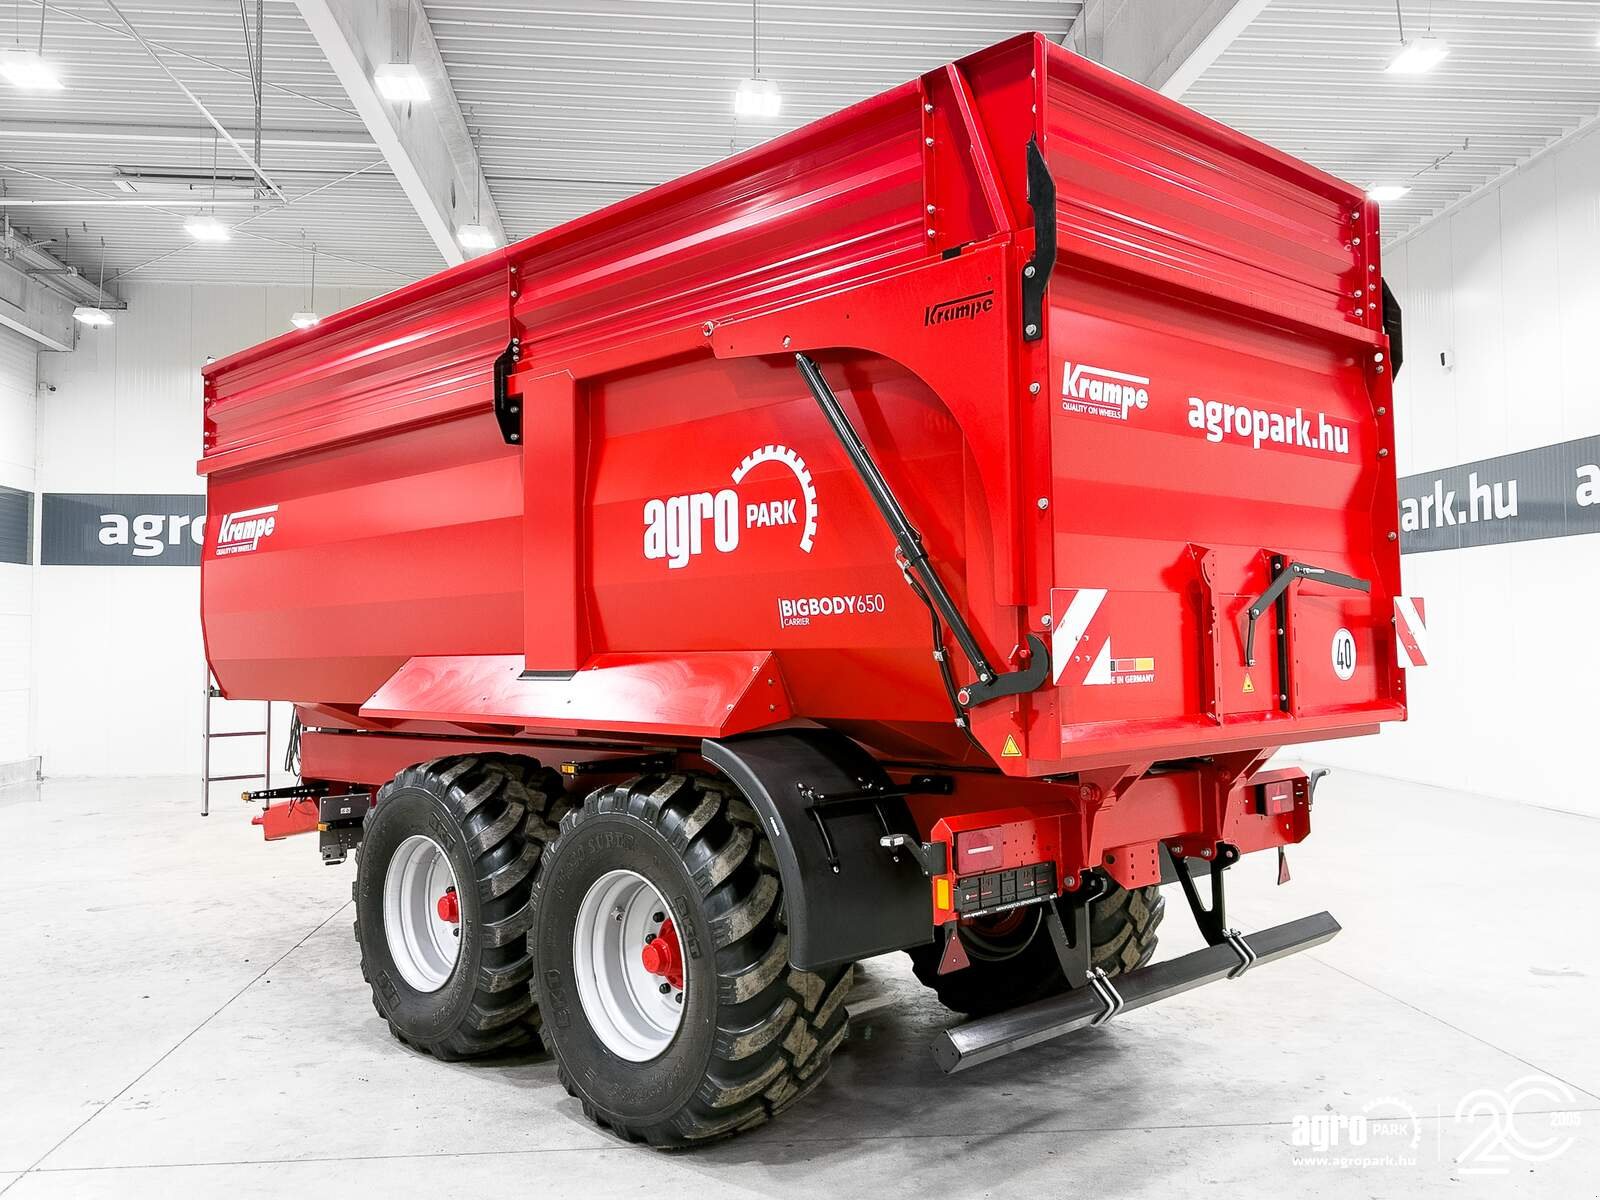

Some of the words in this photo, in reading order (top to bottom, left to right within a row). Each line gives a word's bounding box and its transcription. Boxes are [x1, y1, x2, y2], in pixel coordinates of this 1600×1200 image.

[924, 290, 994, 327] Krampe
[1062, 361, 1150, 420] Krampe
[1062, 402, 1088, 413] QUALITY
[1088, 405, 1098, 415] ON
[1099, 408, 1121, 419] WHEELS
[1188, 397, 1349, 454] agropark.hu
[746, 499, 797, 528] PARK
[1401, 471, 1518, 533] ark.hu
[217, 504, 279, 551] Krampe
[643, 489, 739, 569] agro
[784, 617, 810, 626] CARRIER
[1336, 638, 1352, 670] 40
[1124, 674, 1155, 684] GERMANY
